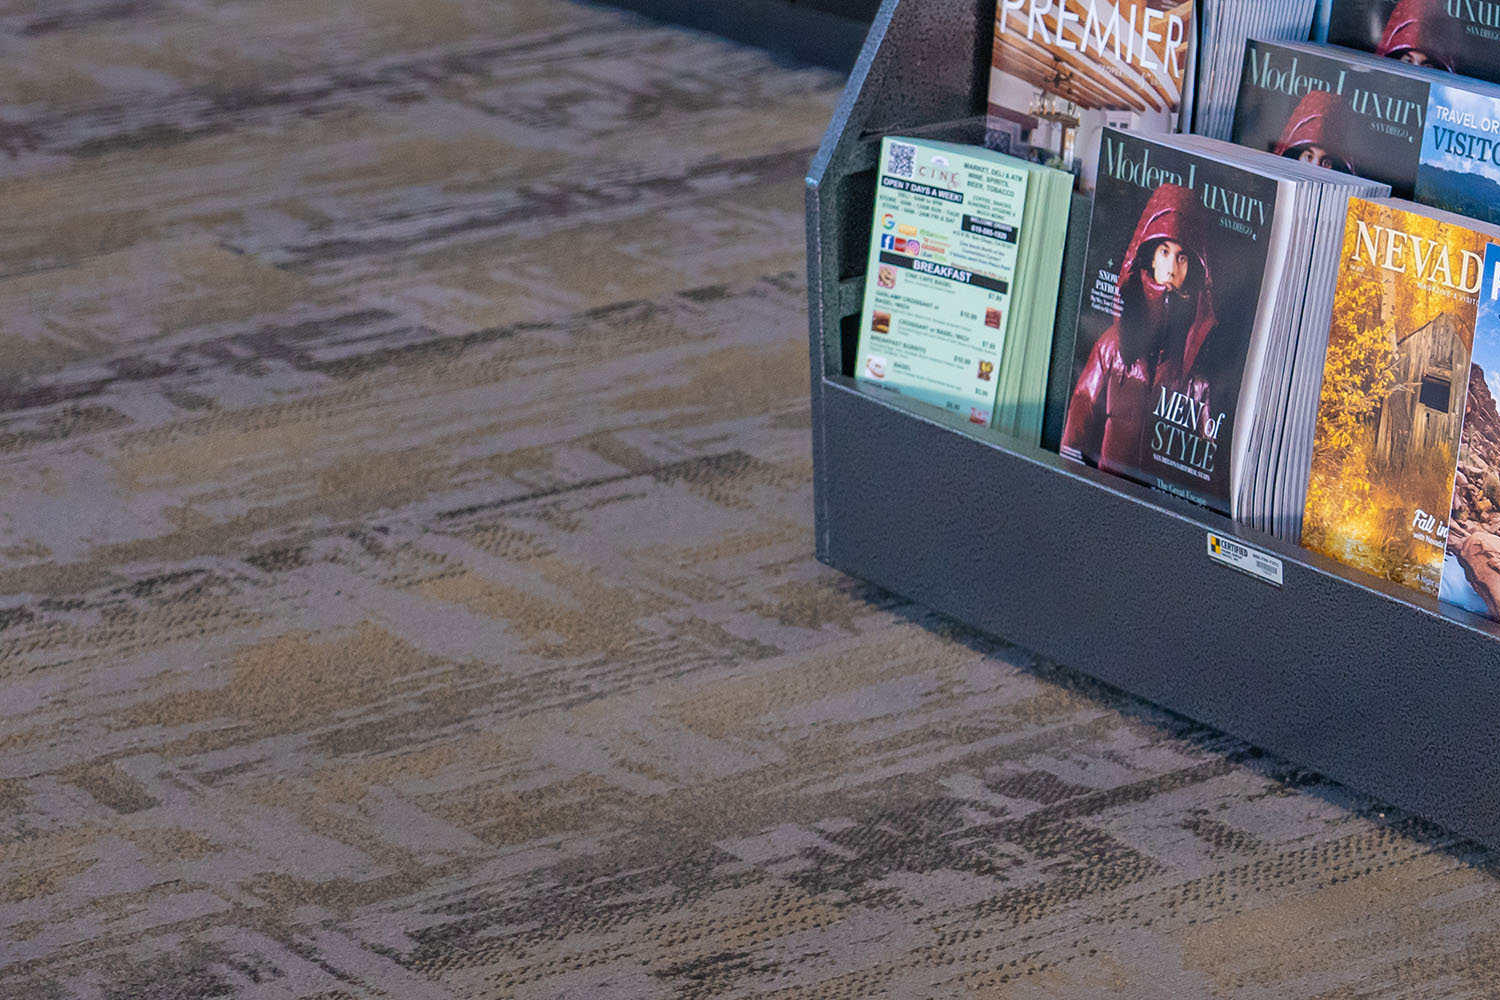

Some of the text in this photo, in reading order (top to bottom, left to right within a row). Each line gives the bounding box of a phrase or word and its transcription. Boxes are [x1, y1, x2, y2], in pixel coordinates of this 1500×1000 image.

[883, 177, 962, 204] OPEN 7 DAYS A WEEK!
[1102, 136, 1271, 229] Modern Luxury
[912, 259, 973, 284] BREAKFAST
[1098, 269, 1120, 285] SNOW
[1152, 385, 1226, 439] MEN of
[1151, 421, 1217, 472] STYLE
[1220, 540, 1248, 558] CERTIFIED
